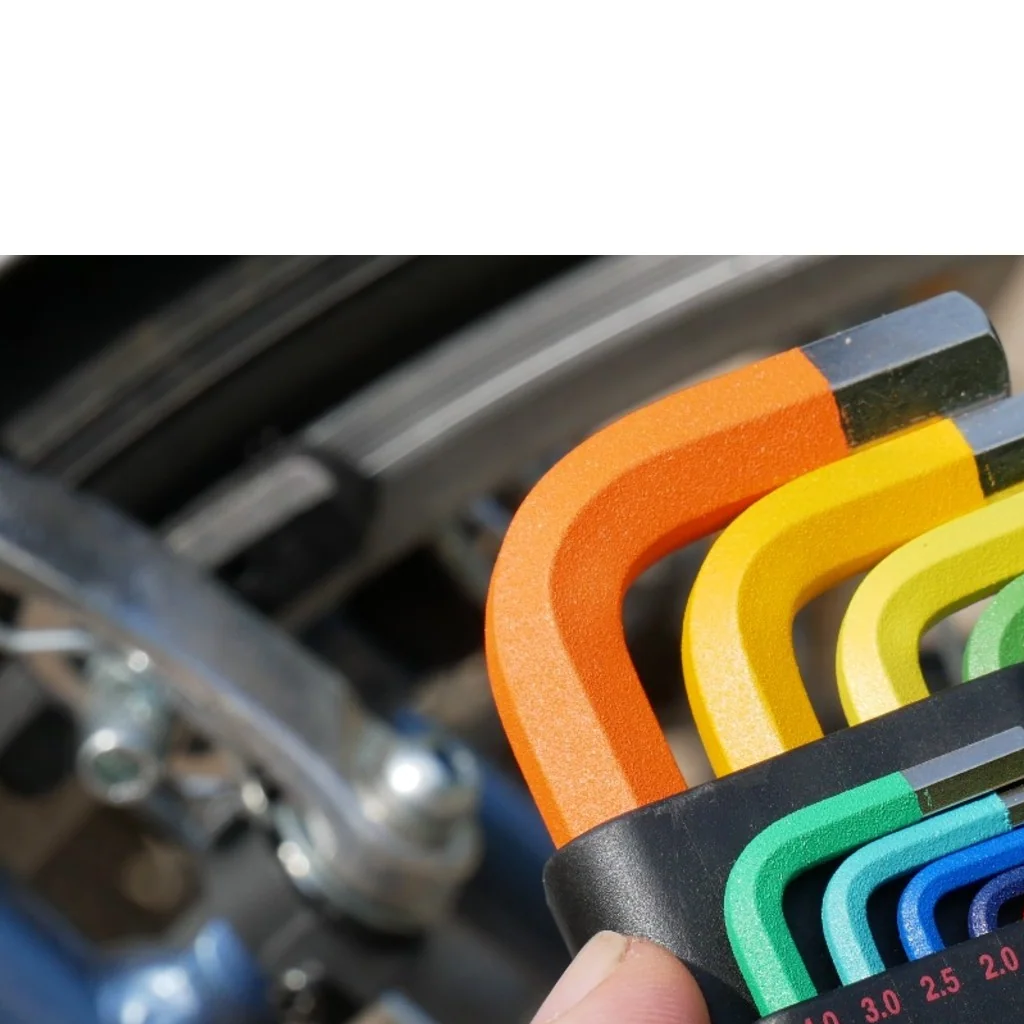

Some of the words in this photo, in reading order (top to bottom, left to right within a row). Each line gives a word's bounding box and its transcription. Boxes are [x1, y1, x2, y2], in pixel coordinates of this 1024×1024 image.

[861, 989, 901, 1024] 3.0
[920, 967, 961, 1002] 2.5
[979, 946, 1020, 981] 2.0
